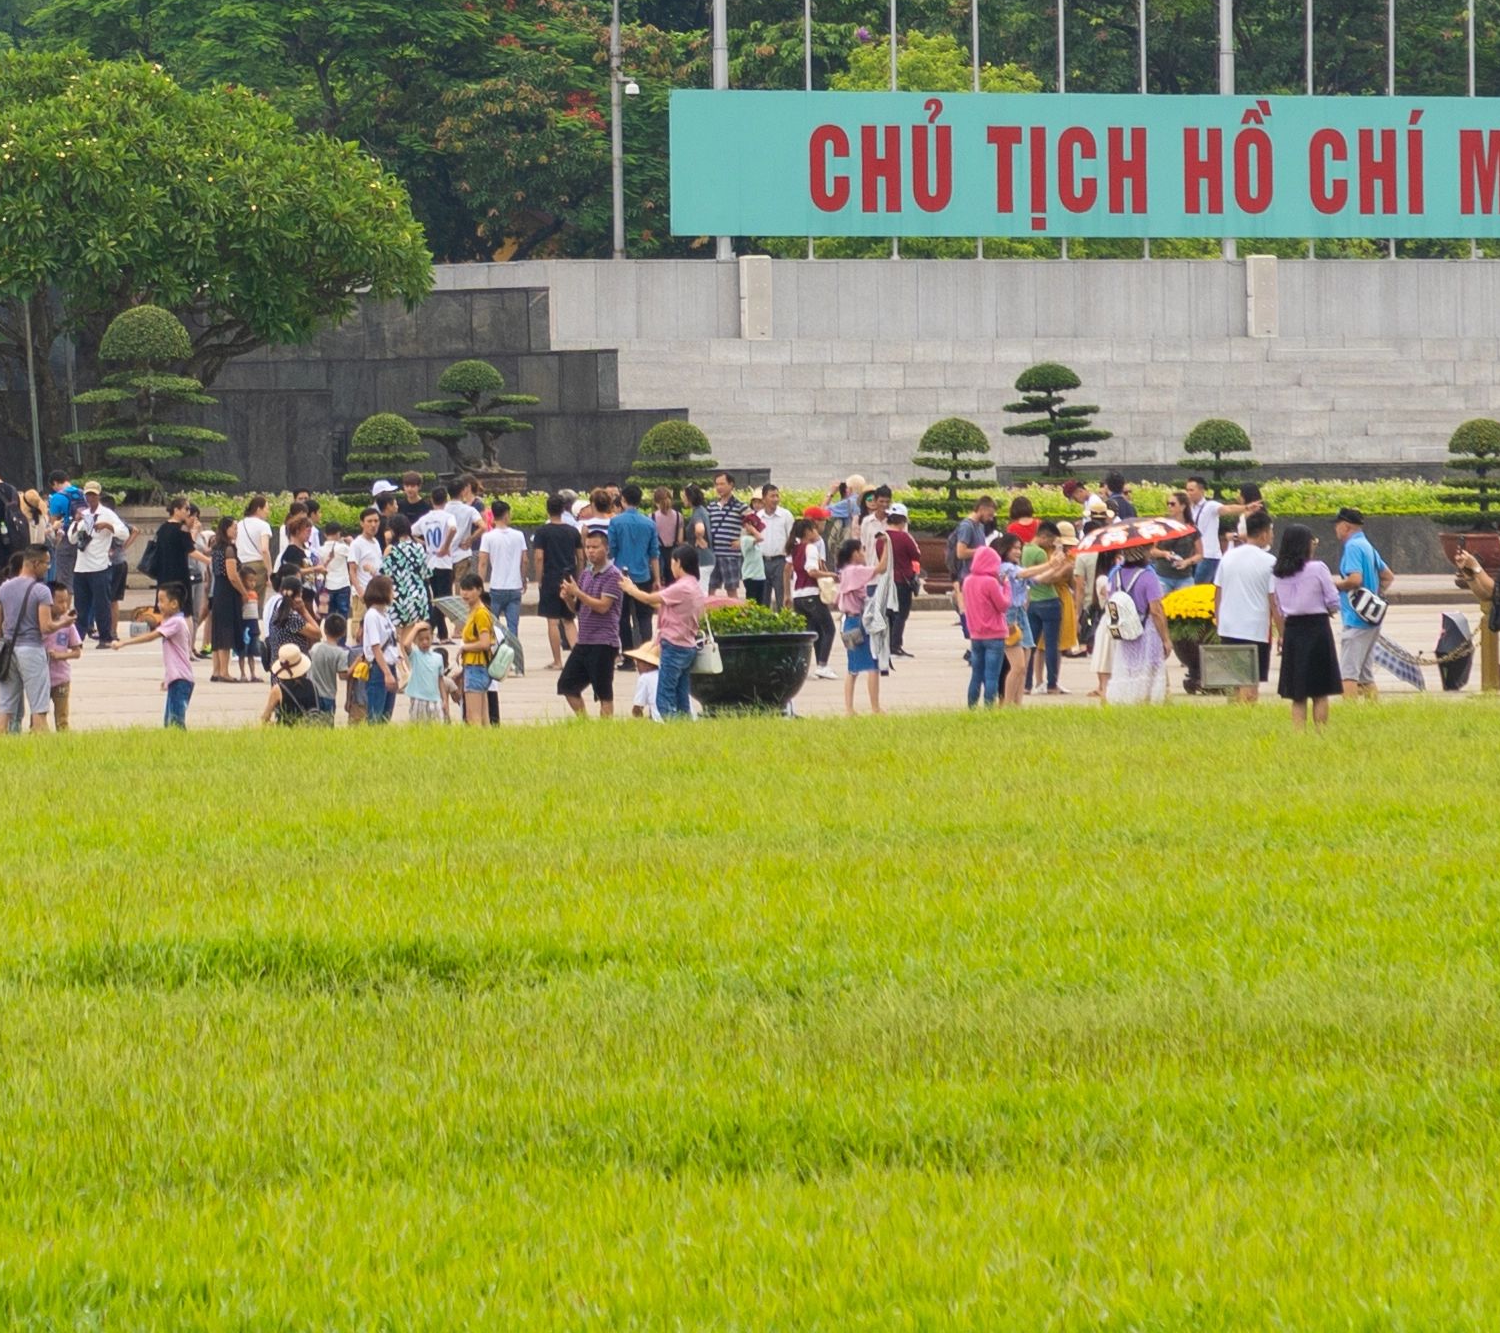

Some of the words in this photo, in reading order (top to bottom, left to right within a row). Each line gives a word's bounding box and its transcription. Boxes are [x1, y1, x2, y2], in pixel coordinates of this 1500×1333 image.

[810, 98, 952, 212] CHỦ
[987, 126, 1147, 230] TỊCH
[1184, 101, 1273, 214] HỒ
[1309, 110, 1424, 214] CHÍ
